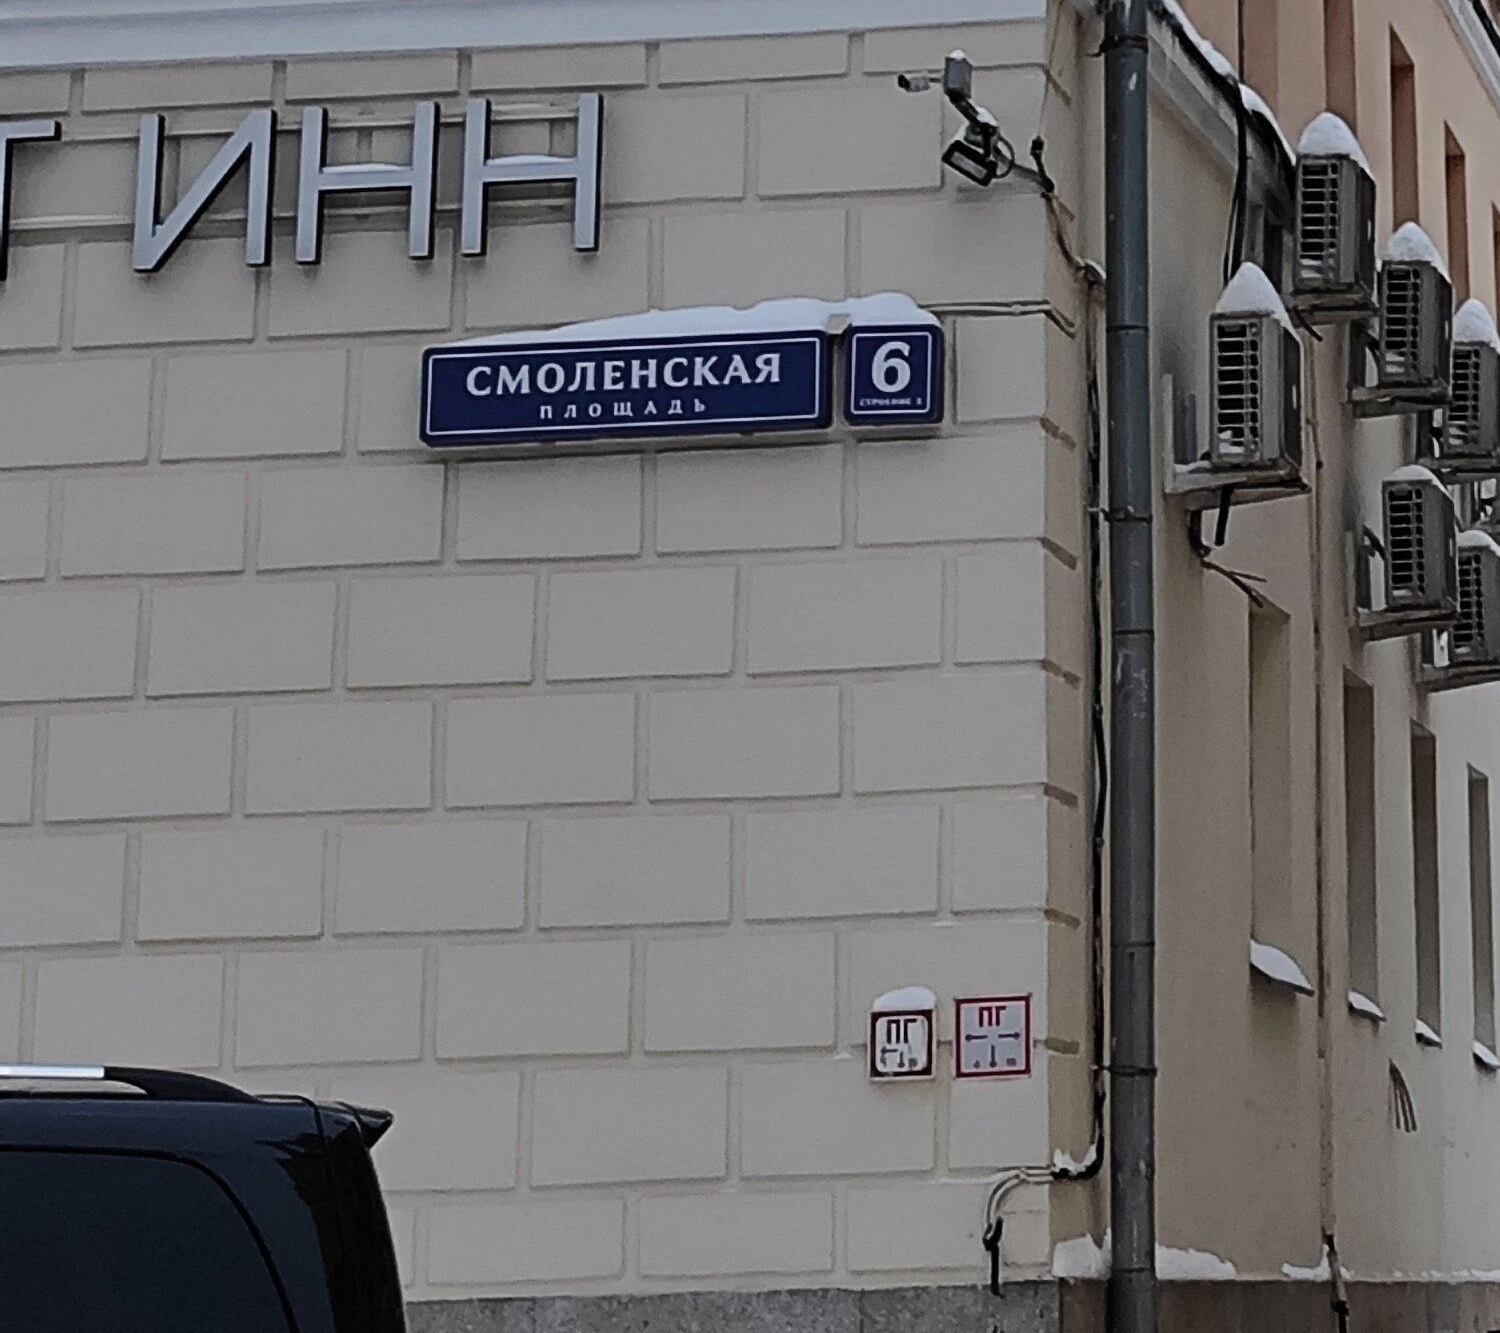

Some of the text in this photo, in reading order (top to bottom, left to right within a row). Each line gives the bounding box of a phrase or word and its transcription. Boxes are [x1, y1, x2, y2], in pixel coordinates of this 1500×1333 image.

[465, 353, 781, 396] СМОЛЕНСКАЯ
[871, 341, 911, 393] 6
[539, 398, 707, 420] ПЛОЩАДЬ
[978, 1005, 1007, 1028] ПГ
[886, 1018, 918, 1044] ПГ
